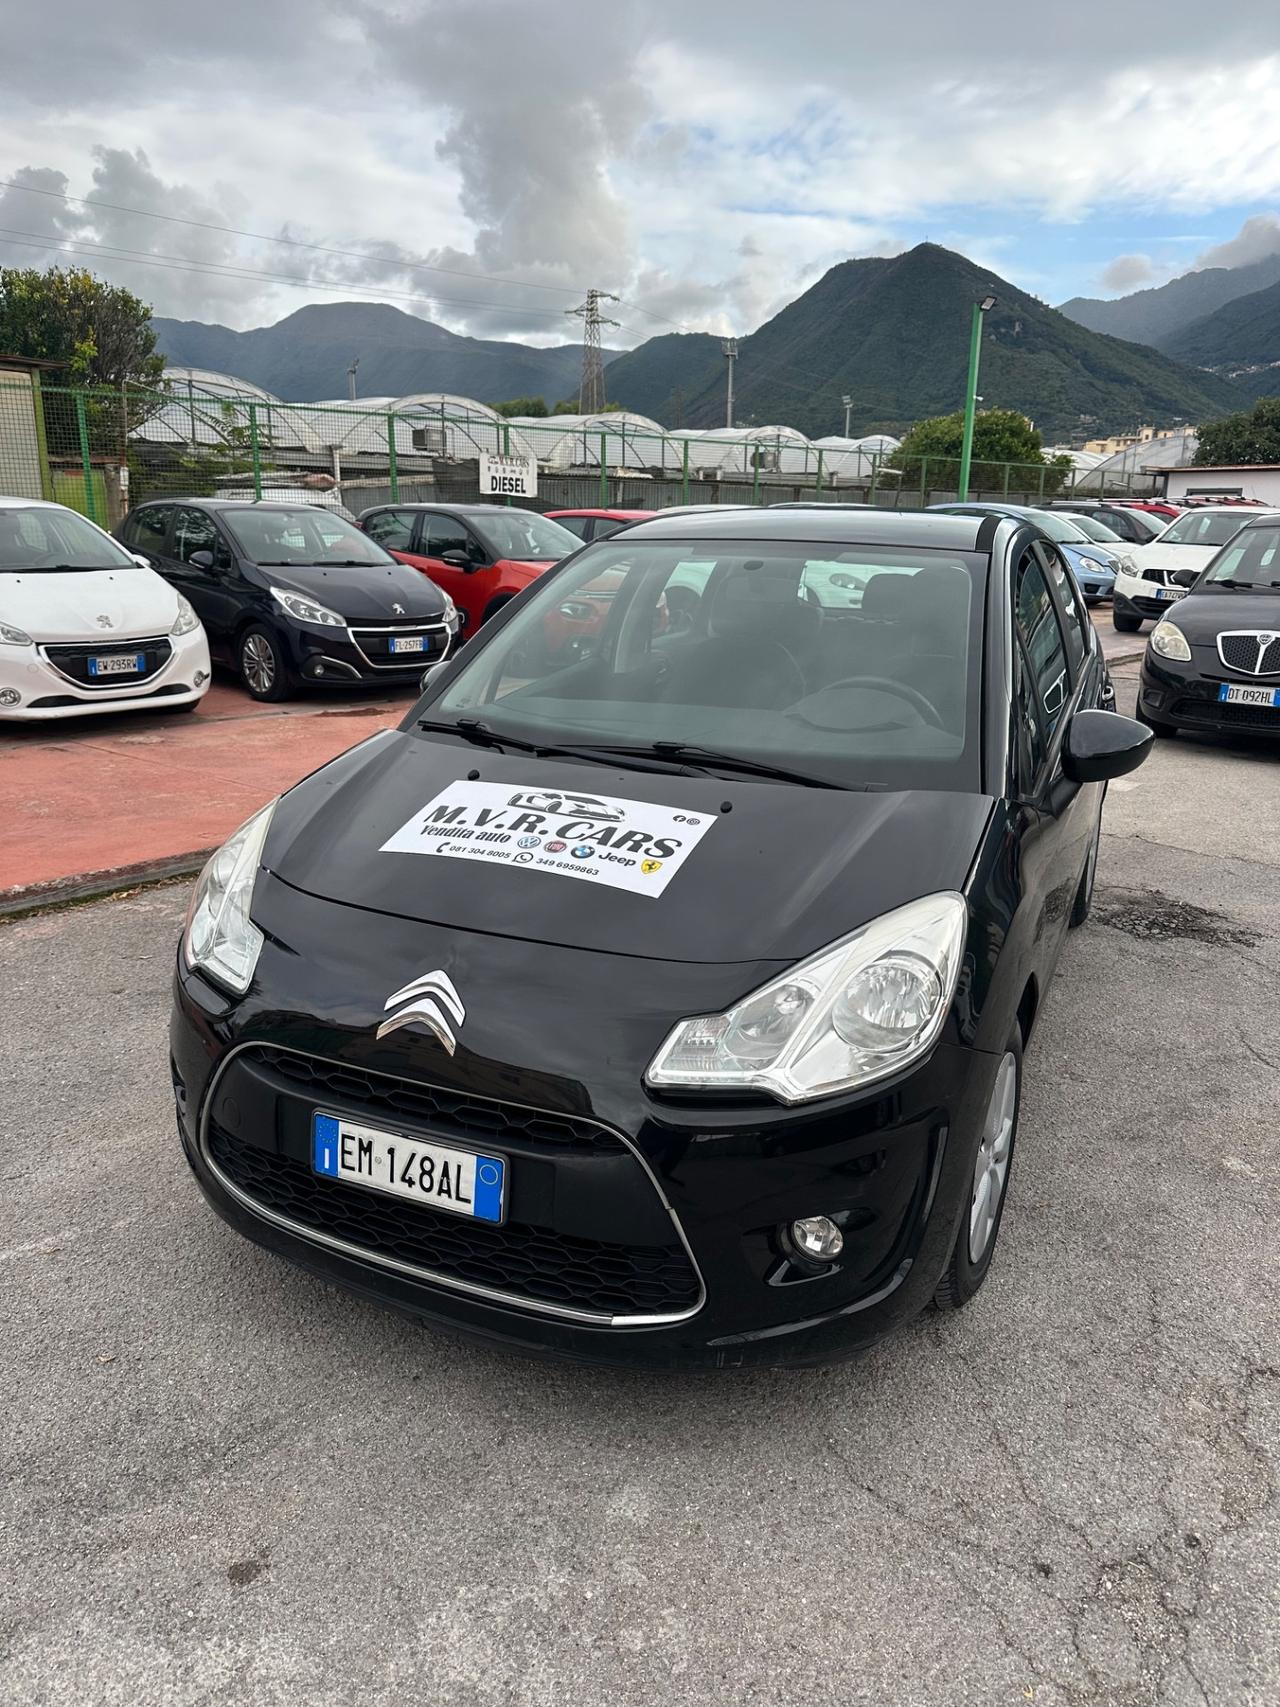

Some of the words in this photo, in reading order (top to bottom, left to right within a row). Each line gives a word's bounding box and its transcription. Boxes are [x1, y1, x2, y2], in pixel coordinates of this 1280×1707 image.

[491, 476, 526, 493] DIESEL
[1228, 688, 1240, 700] DT
[1242, 690, 1272, 703] 092HL
[420, 825, 475, 839] Vendita
[475, 831, 512, 843] auto
[423, 805, 549, 835] M.V.R.
[555, 820, 683, 859] CARS
[486, 849, 511, 859] 8005
[598, 852, 637, 867] Jeep
[536, 857, 555, 866] 349
[556, 861, 600, 876] 6959863
[340, 1133, 373, 1176] EM
[387, 1147, 472, 1204] 148AL
